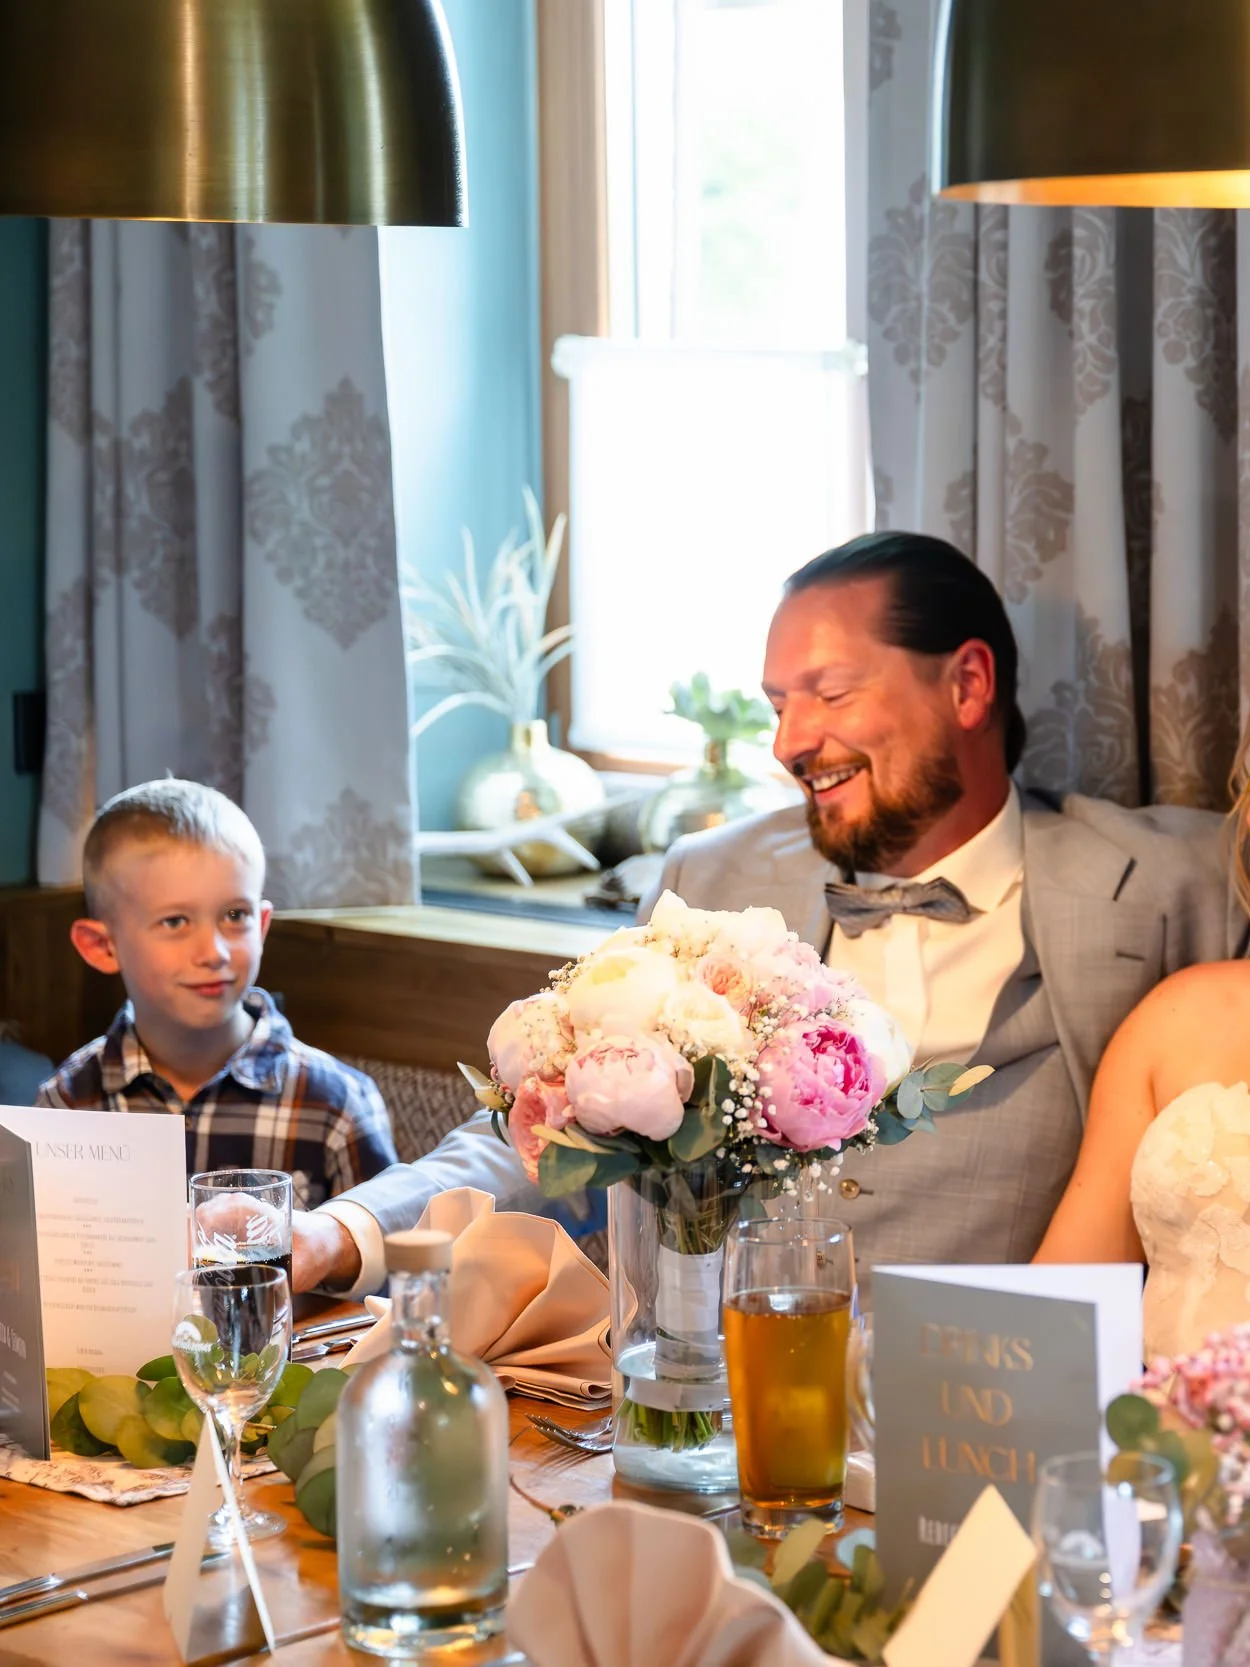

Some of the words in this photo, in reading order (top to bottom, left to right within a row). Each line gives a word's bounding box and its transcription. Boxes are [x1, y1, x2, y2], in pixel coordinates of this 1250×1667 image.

[35, 1141, 84, 1160] UNSER
[941, 1380, 1013, 1427] UND
[922, 1434, 1036, 1484] LUNCH
